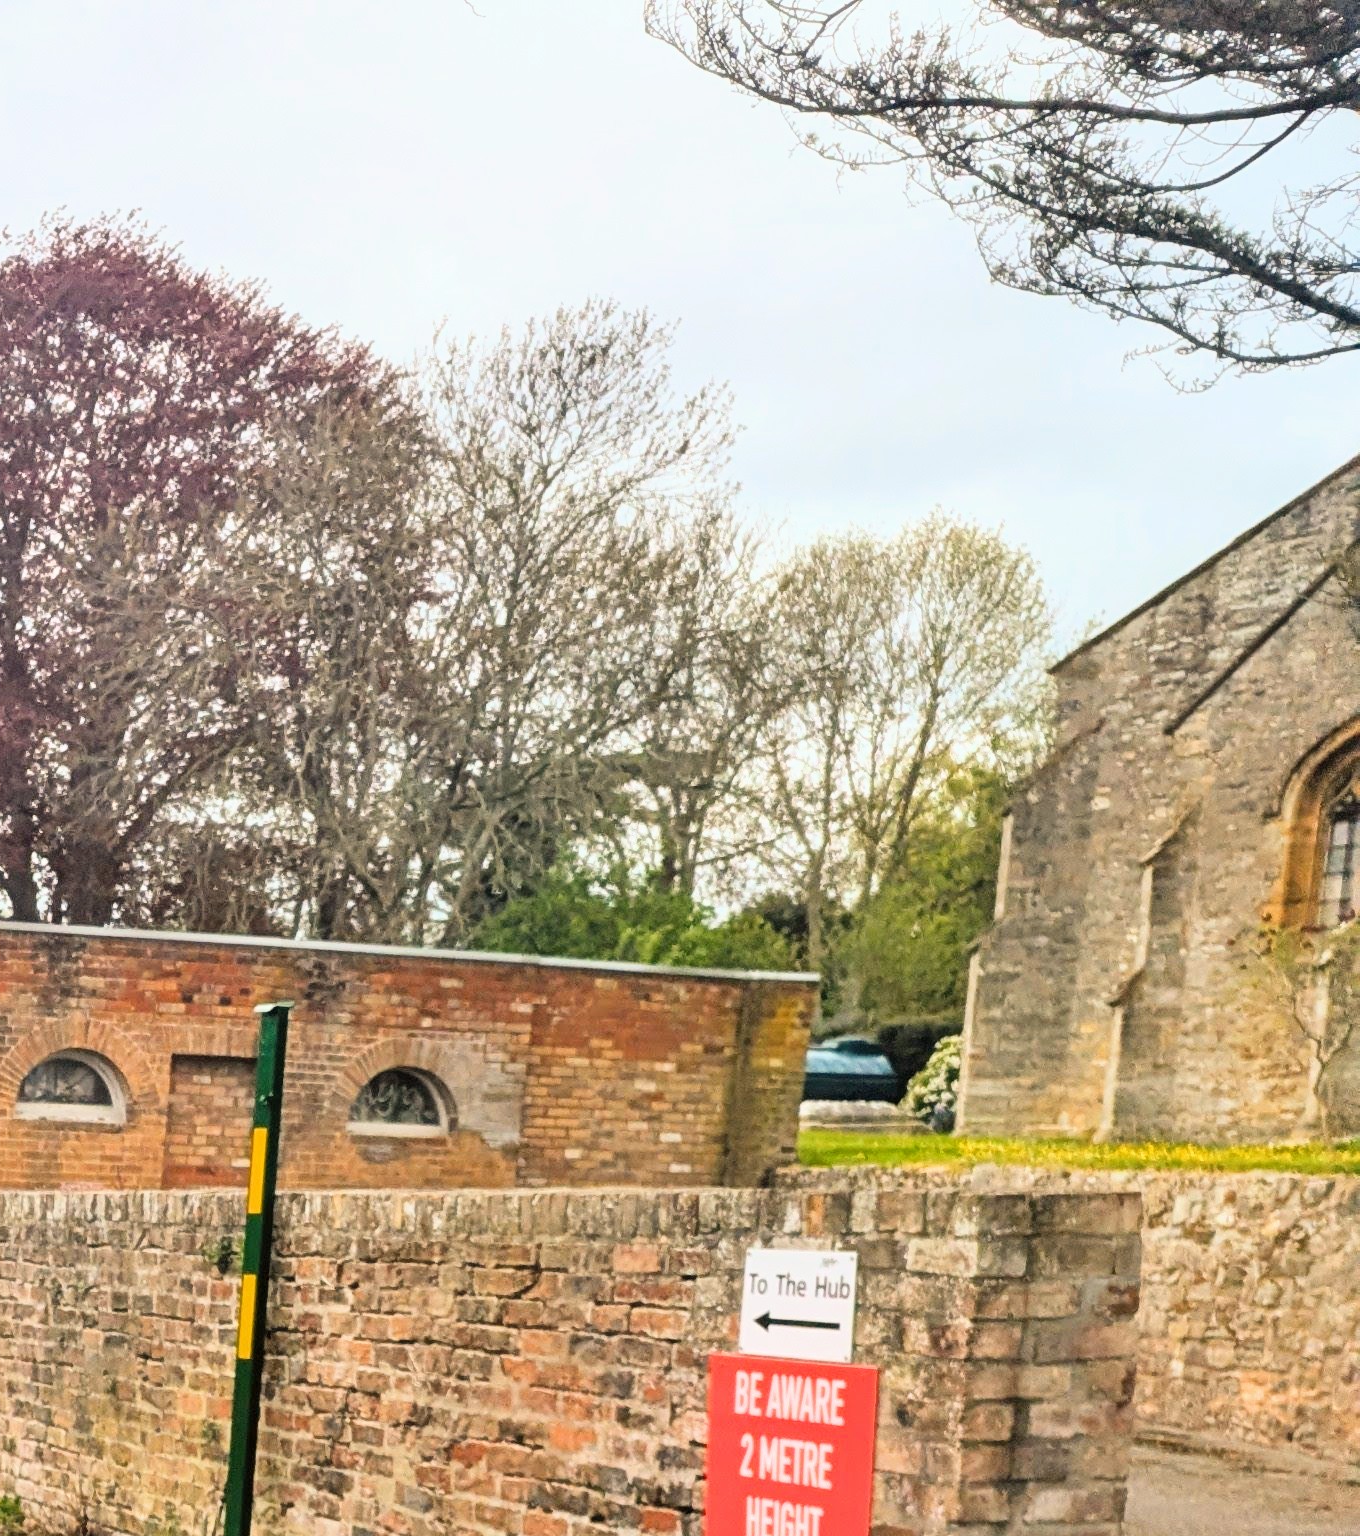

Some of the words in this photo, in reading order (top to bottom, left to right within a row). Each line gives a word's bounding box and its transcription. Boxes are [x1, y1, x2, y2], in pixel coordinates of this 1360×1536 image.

[749, 1273, 768, 1295] To
[776, 1272, 807, 1297] The
[814, 1274, 851, 1299] Hub
[734, 1370, 764, 1417] BE
[765, 1373, 847, 1427] AWARE
[739, 1432, 754, 1478] 2
[758, 1434, 834, 1490] METRE
